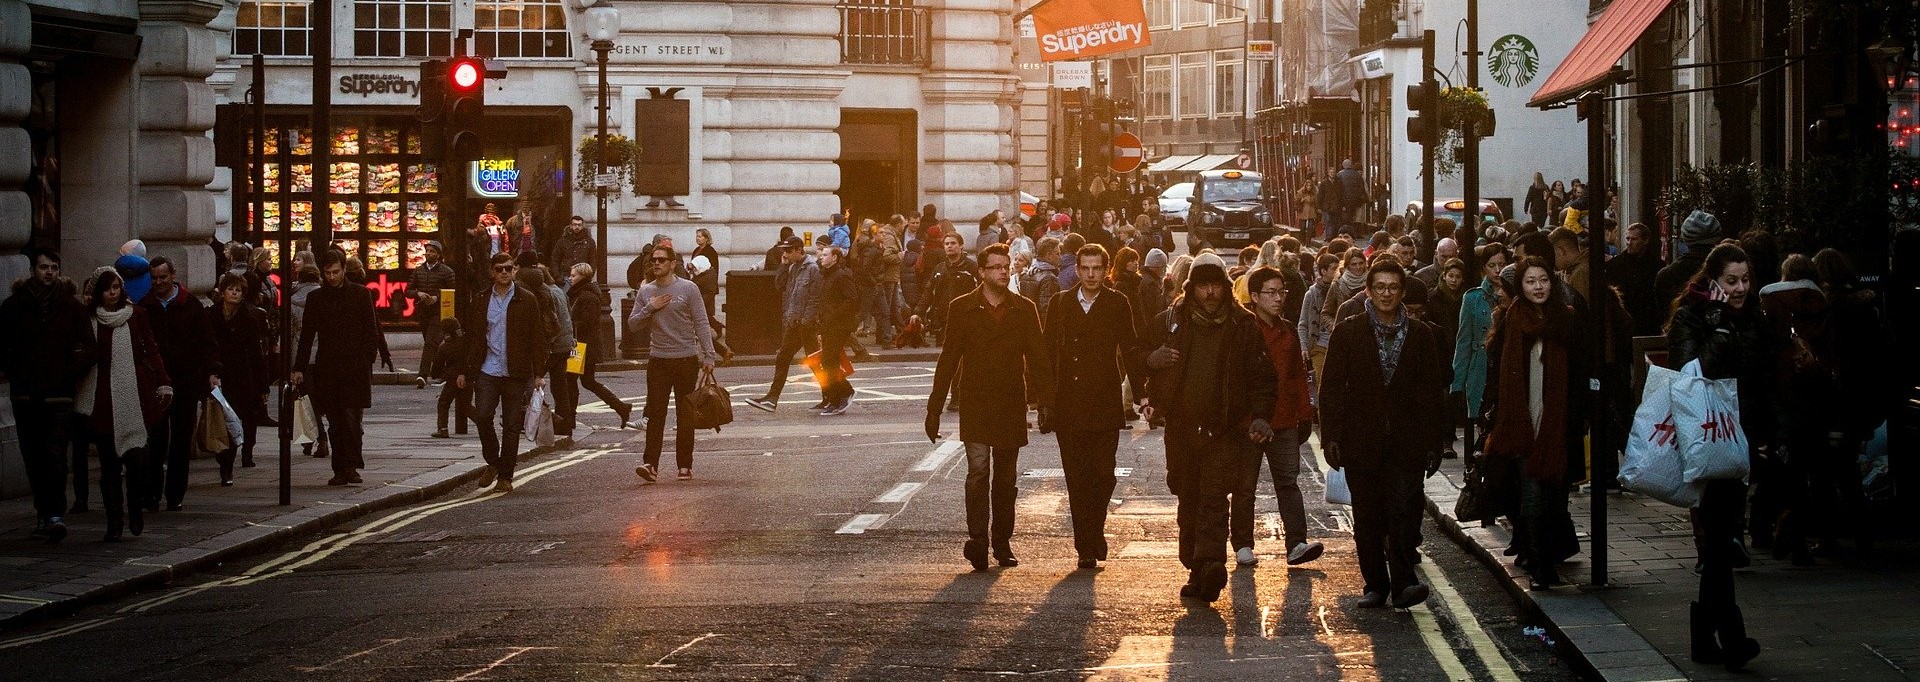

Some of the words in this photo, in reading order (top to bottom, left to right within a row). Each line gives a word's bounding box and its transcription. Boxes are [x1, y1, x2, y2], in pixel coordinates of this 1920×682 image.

[1041, 21, 1142, 54] Superdry
[609, 45, 648, 55] GENT
[658, 46, 701, 55] STREET
[340, 75, 420, 98] Superdry
[480, 160, 515, 170] T-SHIRT
[1700, 408, 1739, 445] H&M
